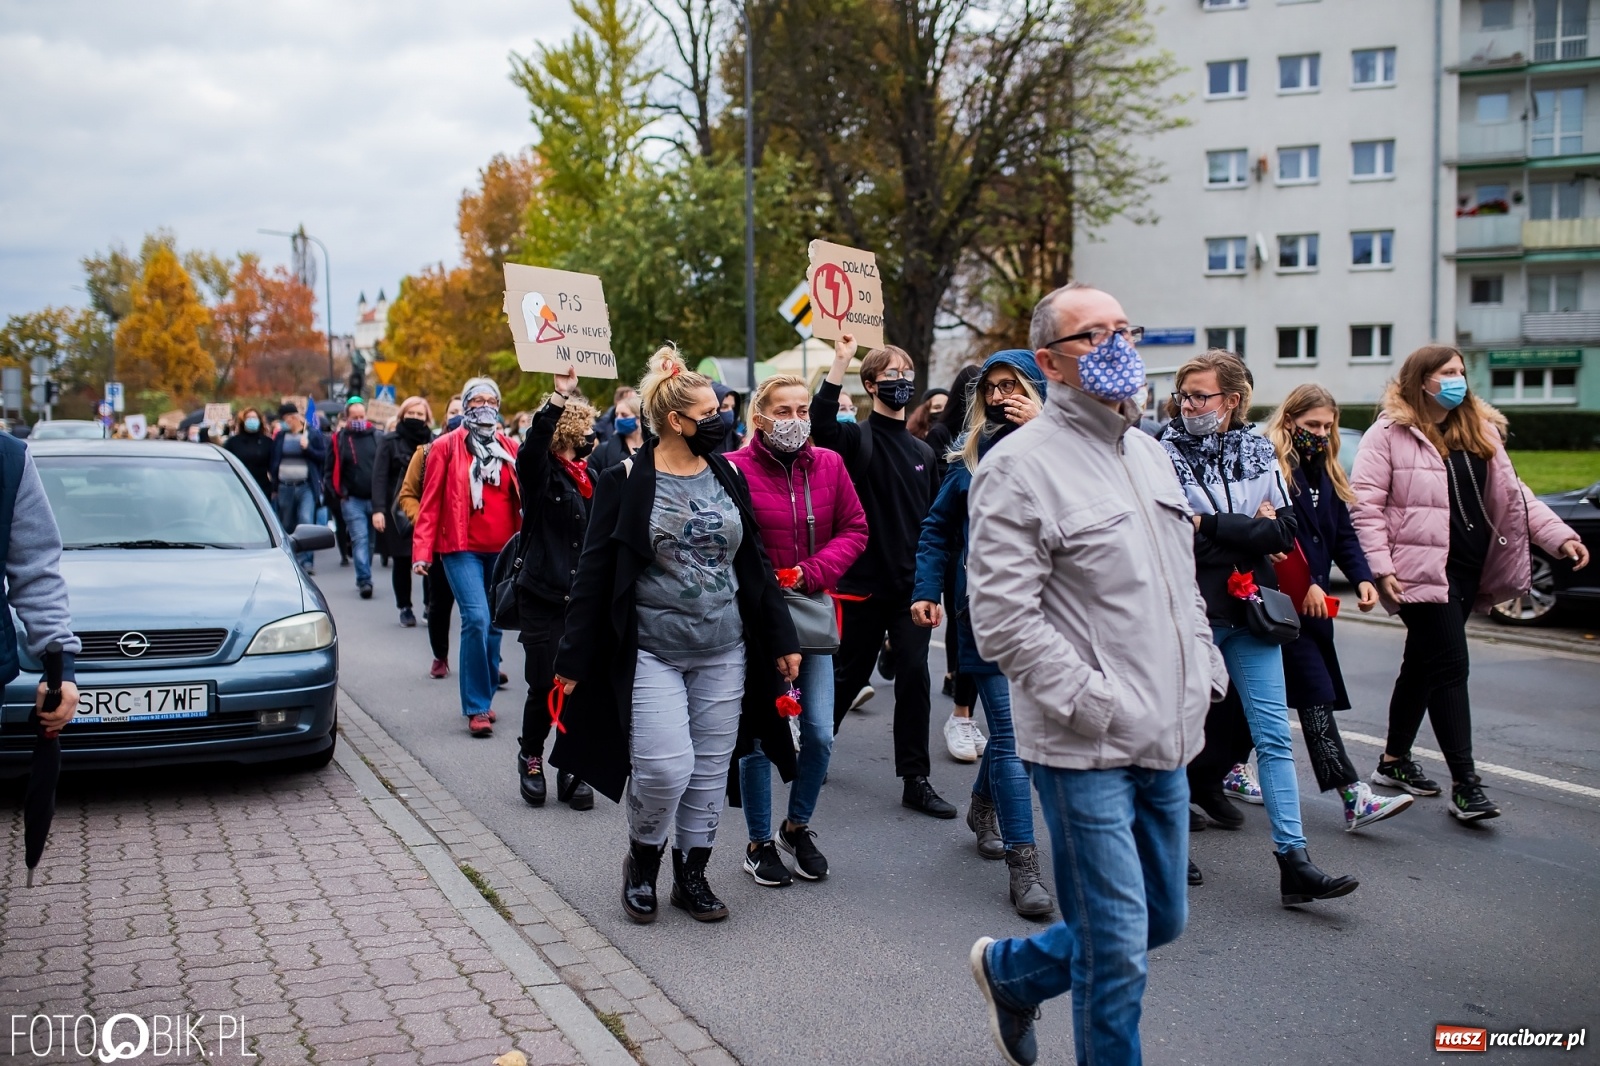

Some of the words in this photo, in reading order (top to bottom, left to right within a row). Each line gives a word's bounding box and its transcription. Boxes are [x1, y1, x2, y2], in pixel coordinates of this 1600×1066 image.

[842, 261, 875, 278] DOŁĄCZ
[558, 292, 582, 312] PiS
[858, 290, 872, 303] DO
[557, 323, 578, 334] WAS
[582, 326, 609, 338] NEVER
[556, 344, 571, 361] AN
[576, 350, 615, 367] OPTION
[77, 690, 131, 715] SRC
[144, 687, 203, 712] 17WF
